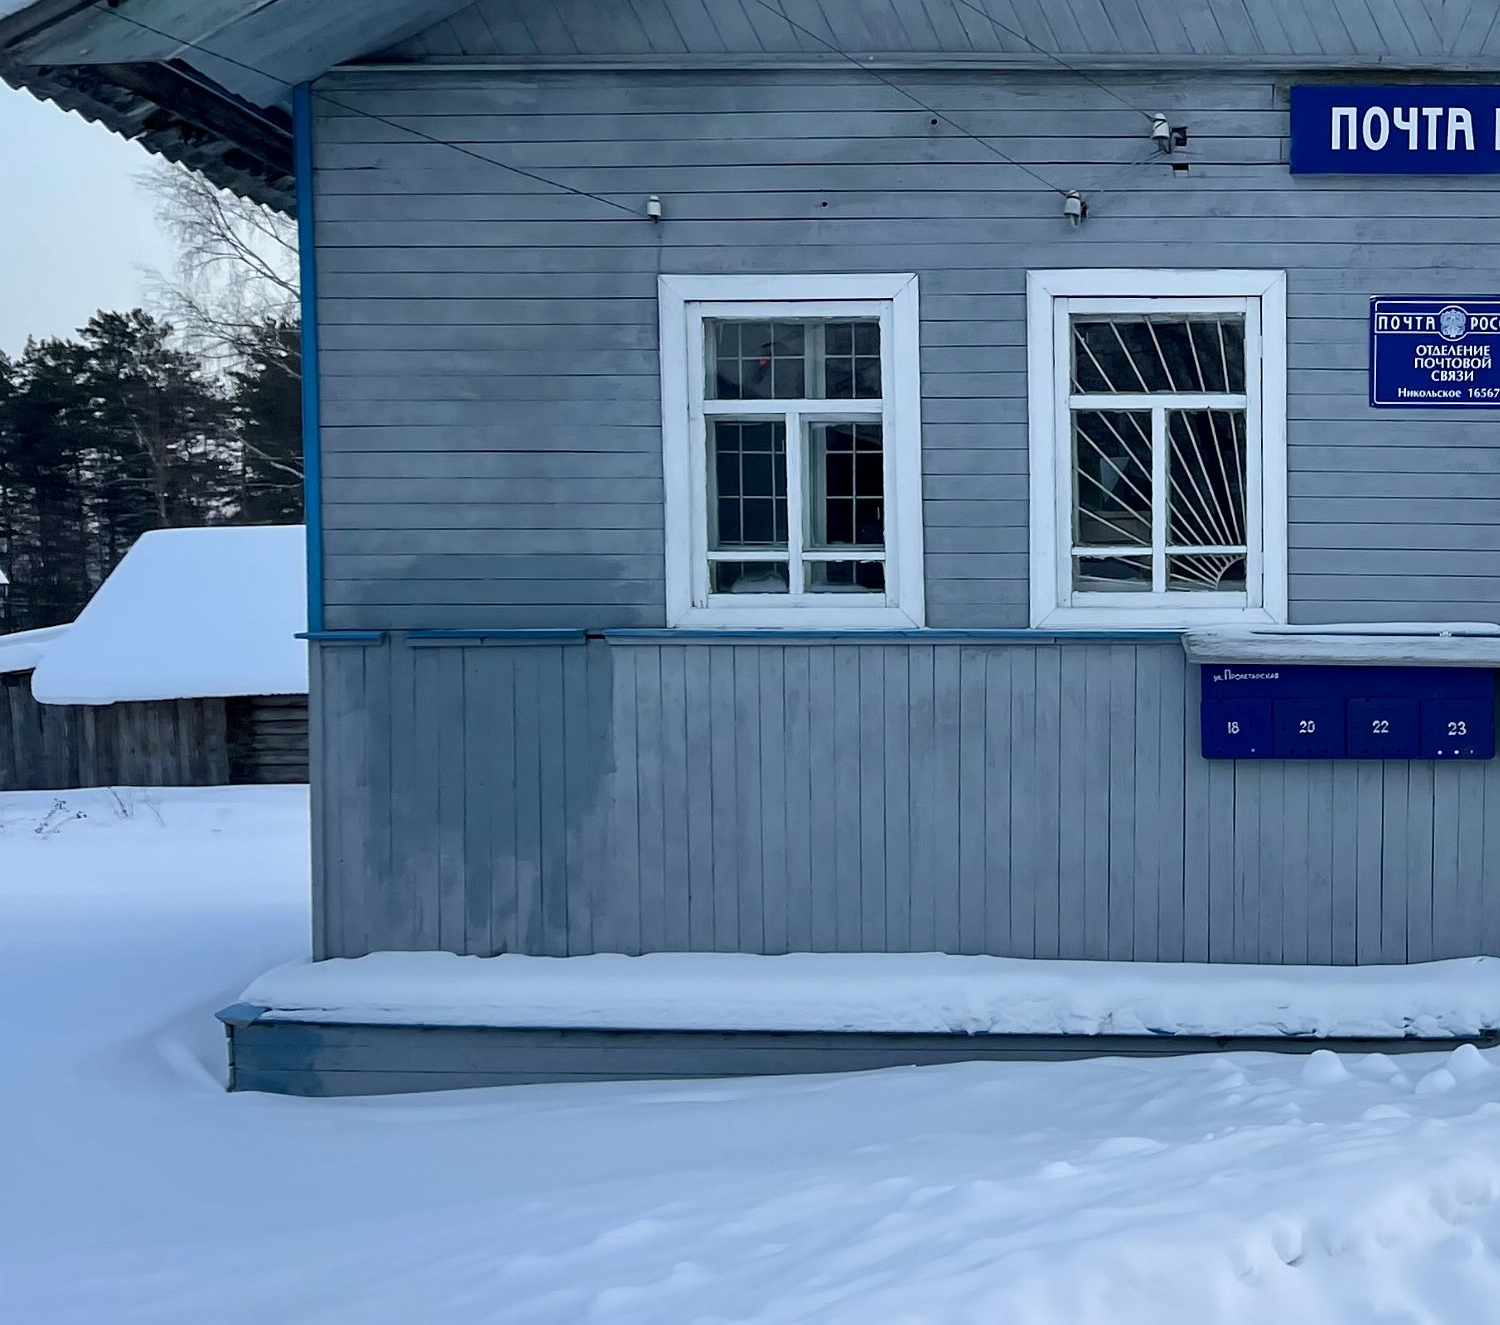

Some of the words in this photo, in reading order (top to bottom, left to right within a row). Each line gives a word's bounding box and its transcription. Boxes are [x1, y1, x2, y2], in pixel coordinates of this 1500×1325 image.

[1331, 105, 1475, 151] ПОЧТА
[1378, 315, 1436, 331] ПОЧТА
[1415, 344, 1491, 357] ОТДЕЛЕНИЕ
[1414, 355, 1492, 369] ПОЧТОВОЙ
[1431, 369, 1474, 382] СВЯЗИ
[1397, 387, 1462, 398] Никольское
[1227, 721, 1240, 734] 18
[1299, 720, 1316, 734] 20
[1372, 720, 1389, 734] 22
[1447, 720, 1467, 736] 23
